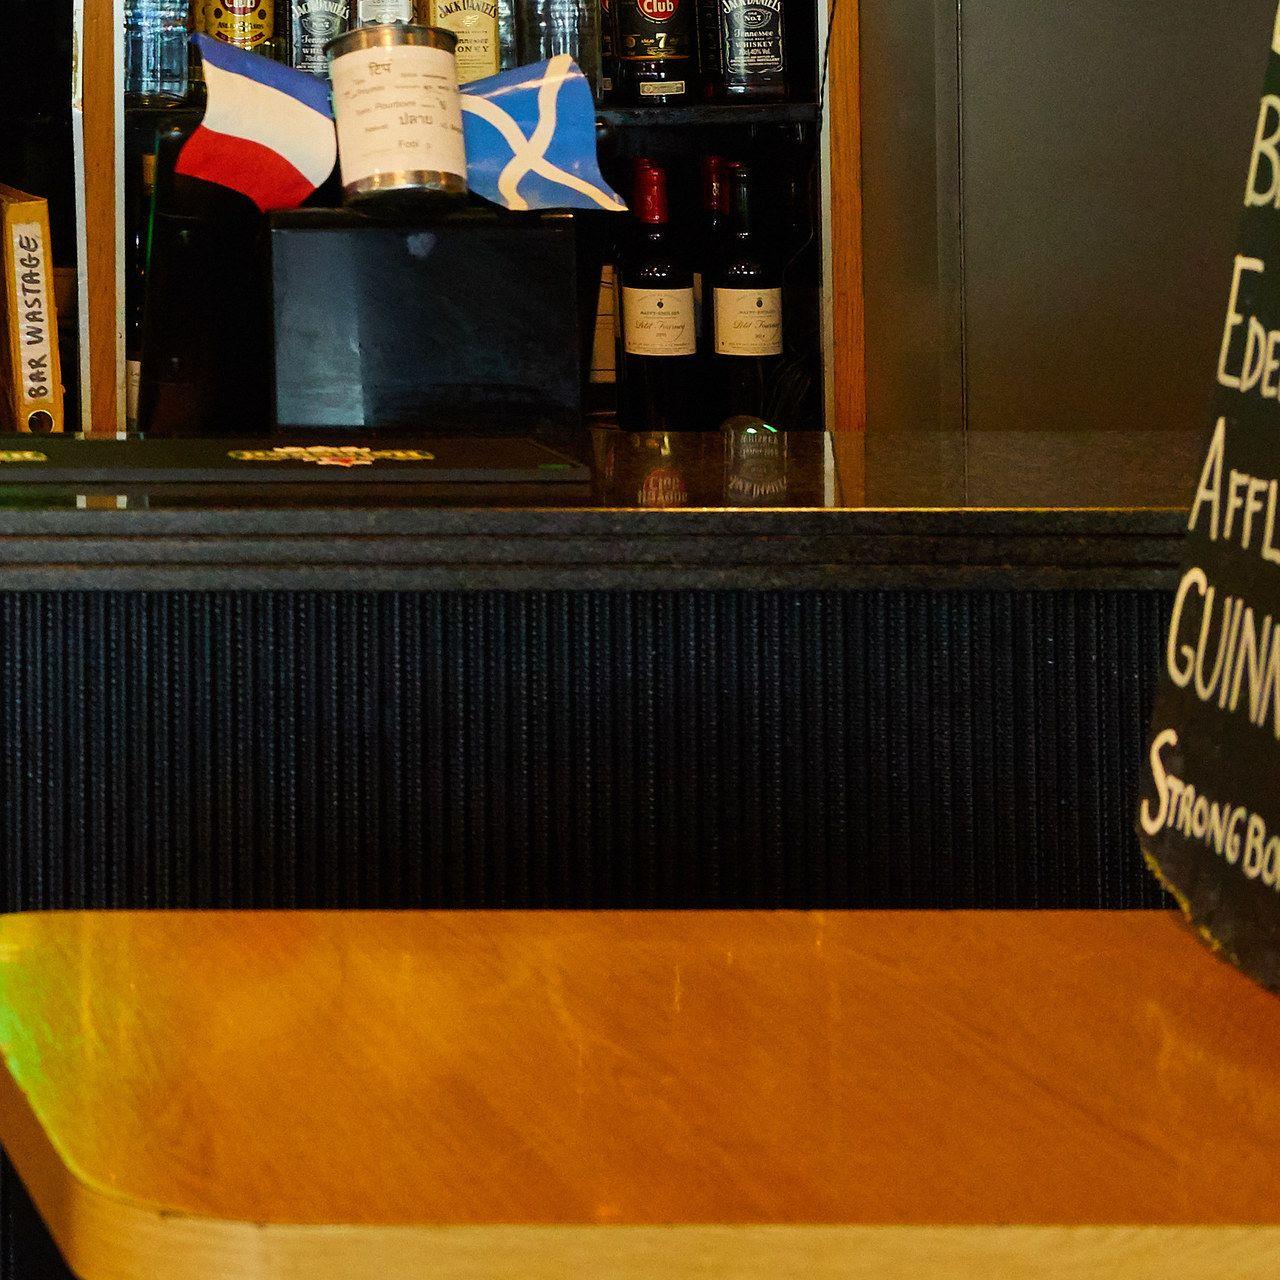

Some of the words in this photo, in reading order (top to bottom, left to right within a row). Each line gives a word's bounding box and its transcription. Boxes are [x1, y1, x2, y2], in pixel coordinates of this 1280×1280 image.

[439, 1, 462, 19] JACK
[655, 32, 666, 48] 7
[20, 235, 50, 348] WASTAGE
[26, 358, 50, 402] BAR
